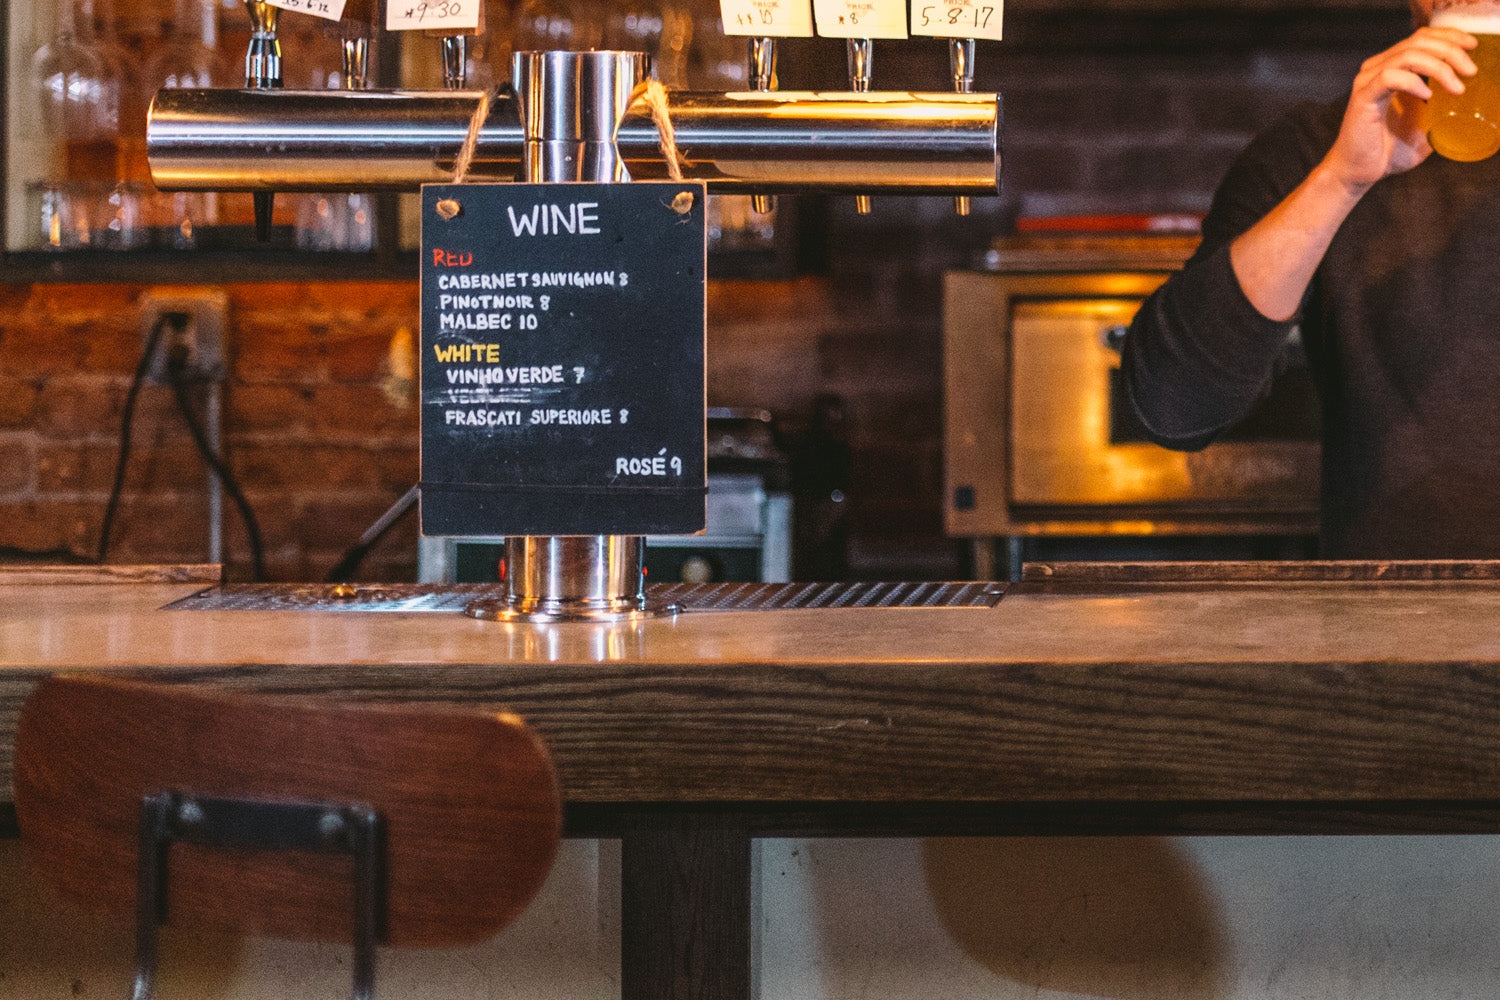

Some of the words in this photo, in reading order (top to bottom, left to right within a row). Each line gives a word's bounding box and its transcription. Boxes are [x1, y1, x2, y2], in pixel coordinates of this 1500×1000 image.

[508, 202, 601, 236] WINE
[433, 249, 473, 267] RED
[439, 273, 528, 289] CABERNET
[532, 271, 615, 287] SAUVIGNON
[619, 273, 628, 287] 8
[540, 295, 550, 311] 8
[440, 315, 512, 330] MALBEC
[520, 315, 538, 330] 10
[434, 344, 500, 363] WHITE
[506, 365, 564, 383] VERDE
[573, 367, 585, 385] 7
[445, 410, 521, 426] FRASCATI
[530, 410, 611, 425] SUPERIORE
[620, 409, 629, 424] 8
[616, 448, 667, 475] ROSÉ
[670, 459, 682, 475] 9
